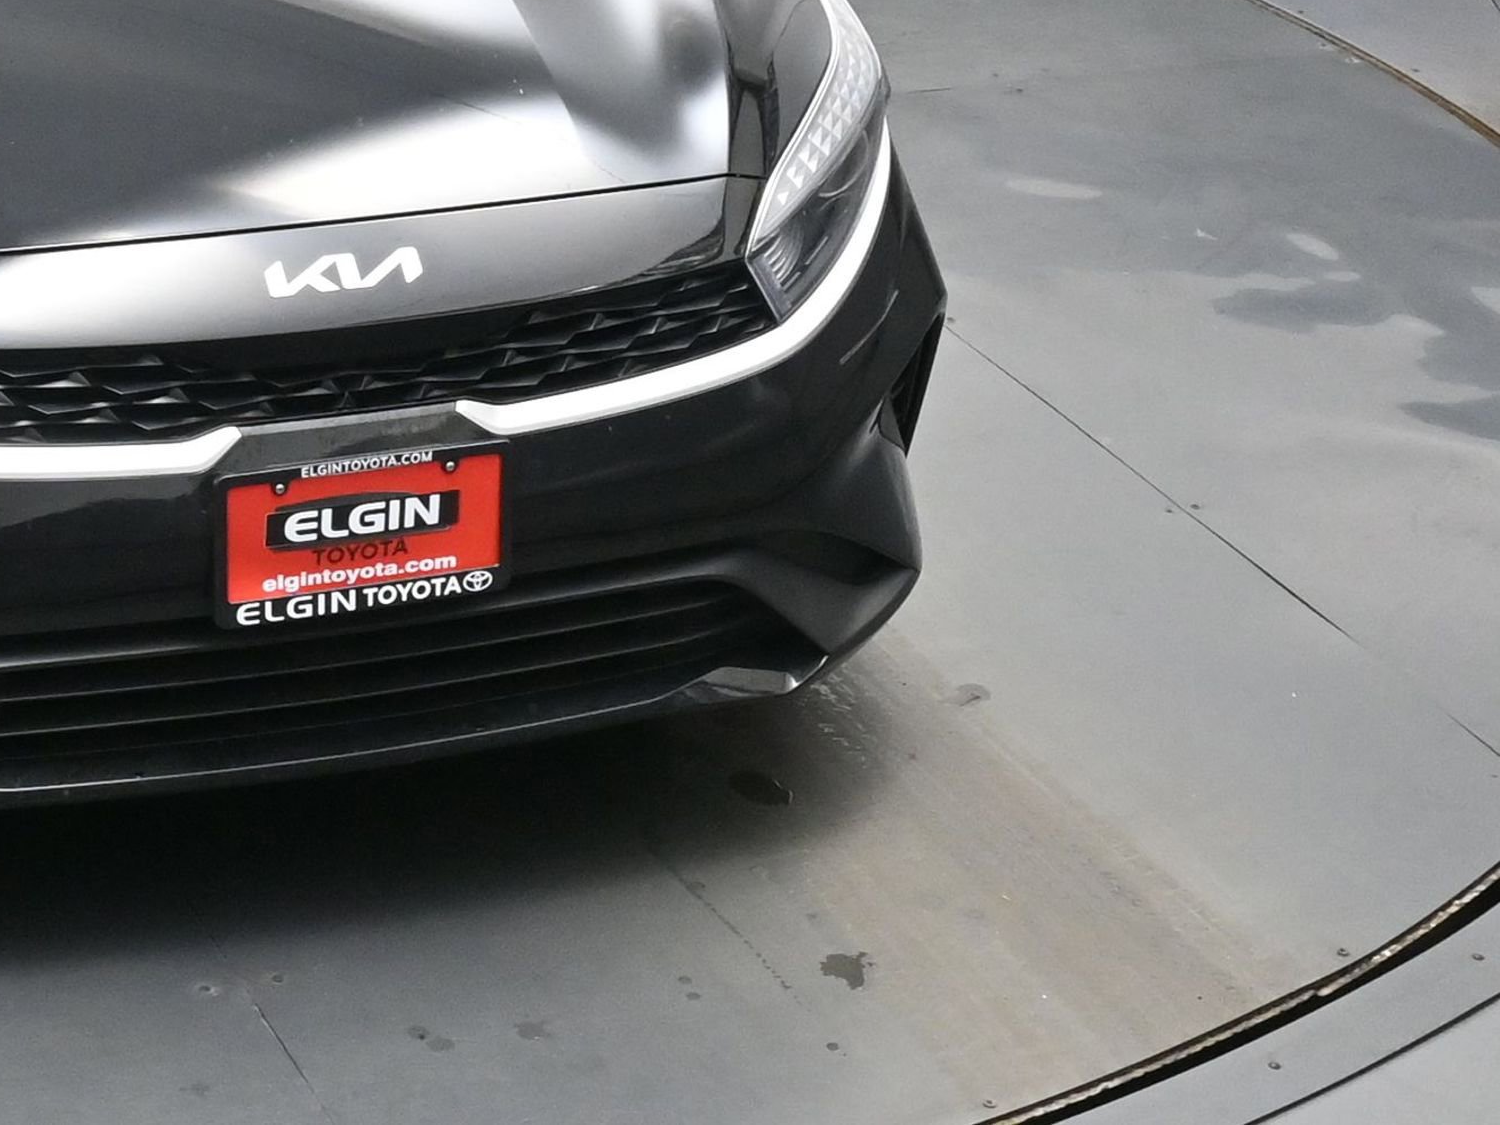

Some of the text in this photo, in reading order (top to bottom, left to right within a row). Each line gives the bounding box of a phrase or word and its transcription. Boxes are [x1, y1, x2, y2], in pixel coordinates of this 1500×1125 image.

[301, 451, 433, 479] ELGINTOYOTA.COM
[284, 493, 442, 543] ELGIN
[312, 537, 409, 567] TOYOTA
[262, 555, 457, 593] elgintoyota.com
[235, 576, 462, 626] ELGIN TOYOTA
